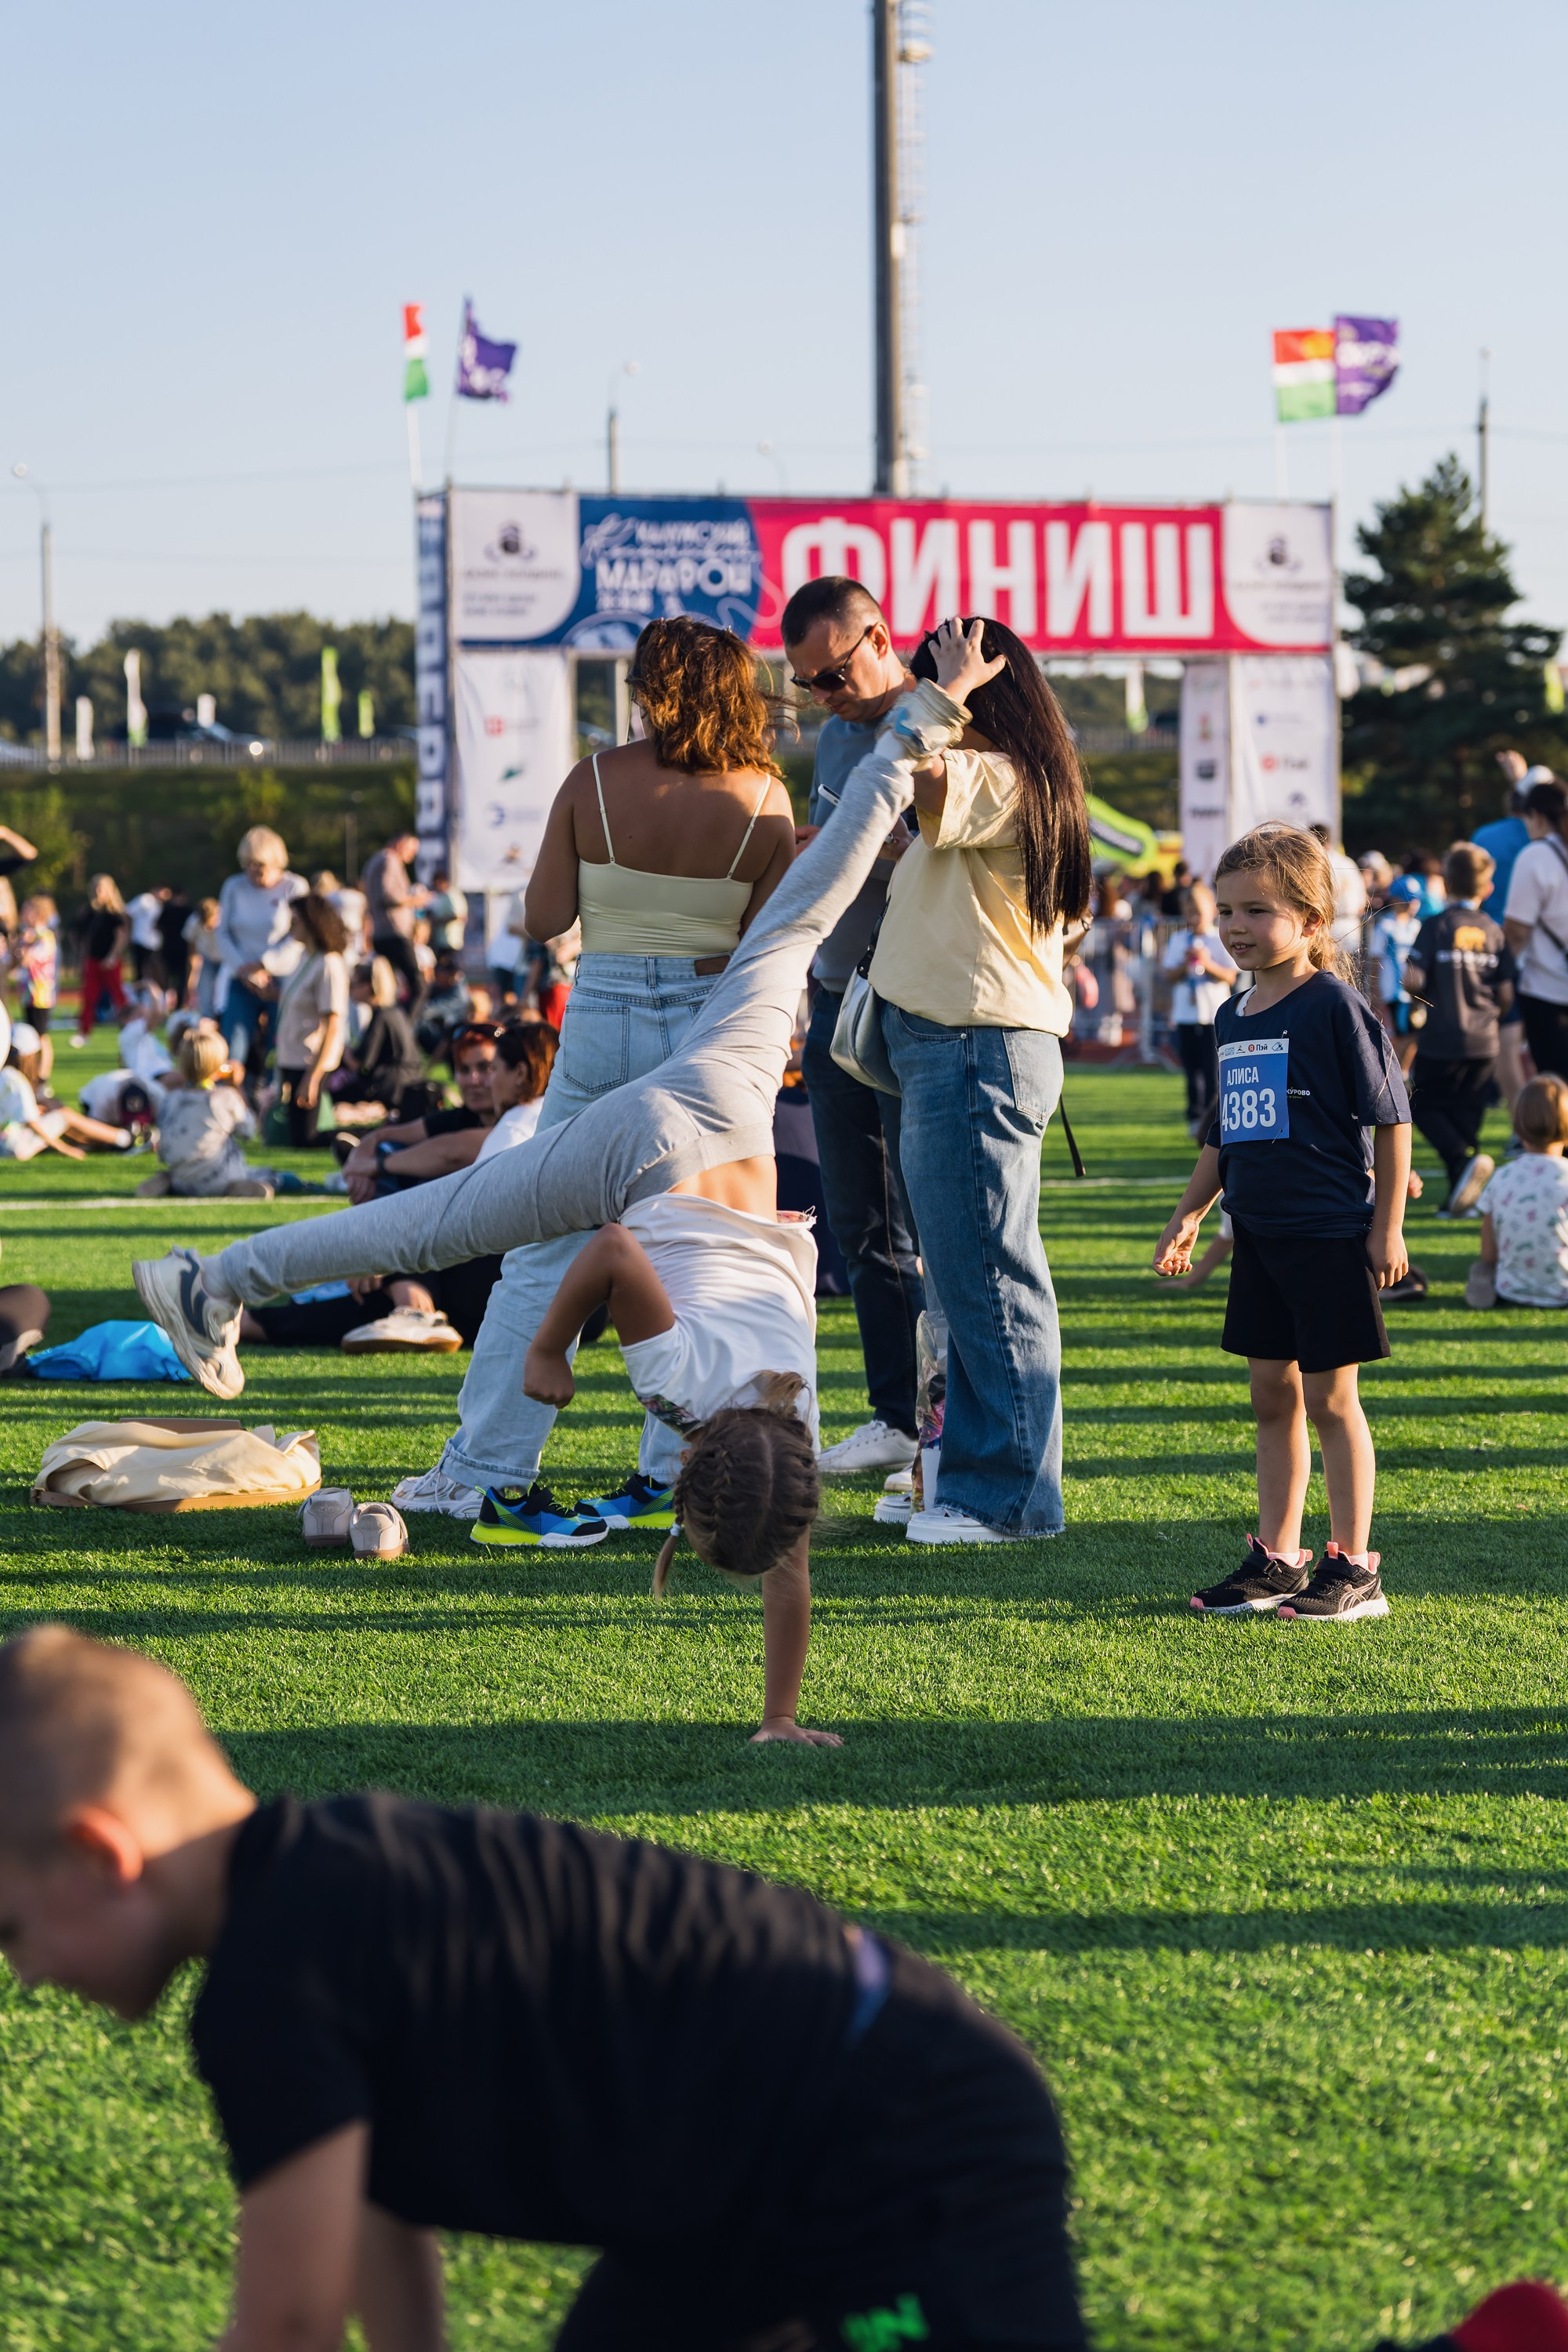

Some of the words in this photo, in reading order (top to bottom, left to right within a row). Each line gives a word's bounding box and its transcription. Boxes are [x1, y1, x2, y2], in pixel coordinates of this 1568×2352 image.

[782, 517, 1213, 638] ФИНИШ
[1226, 1067, 1259, 1086] АЛИСА
[1222, 1088, 1276, 1131] 4383
